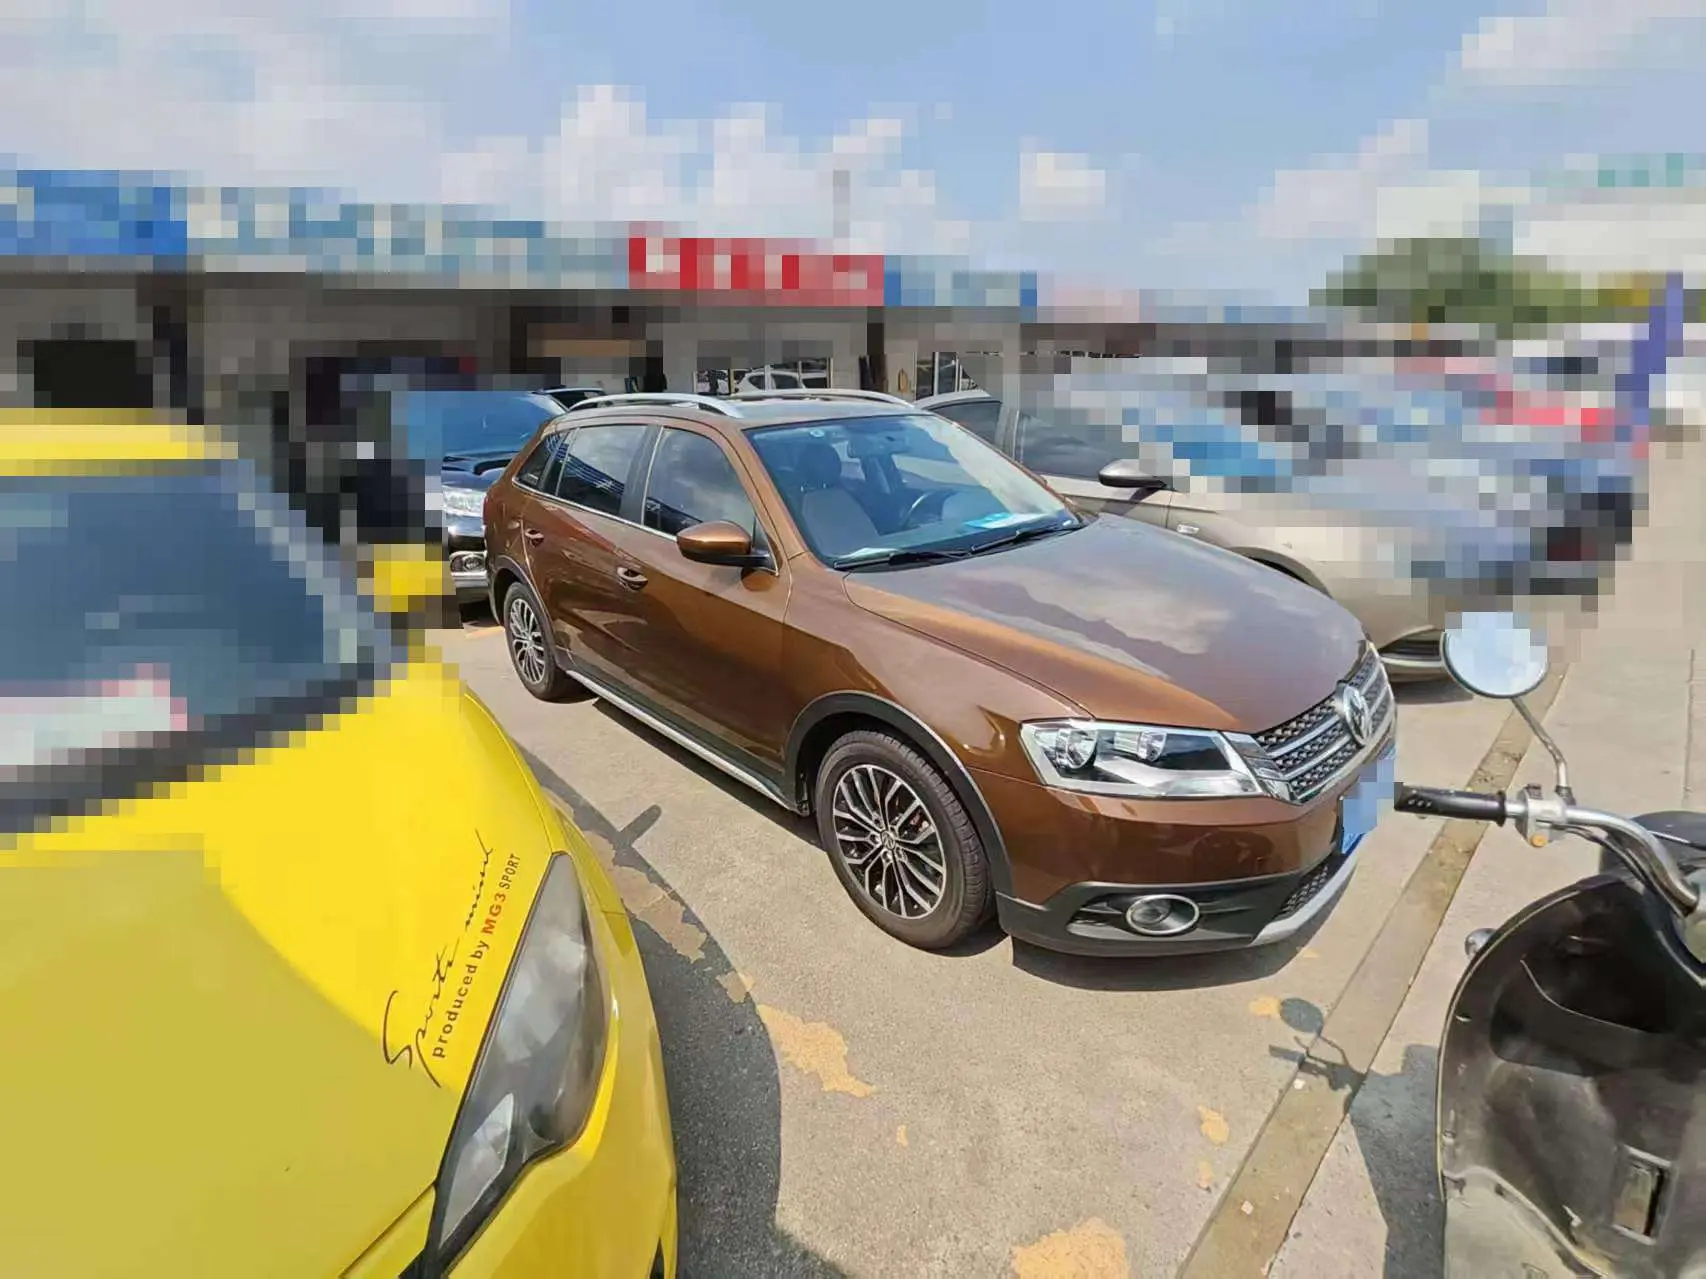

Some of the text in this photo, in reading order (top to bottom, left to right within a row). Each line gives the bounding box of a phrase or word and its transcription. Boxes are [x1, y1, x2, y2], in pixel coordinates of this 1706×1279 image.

[432, 852, 521, 1059] produced by MG3 SPORT
